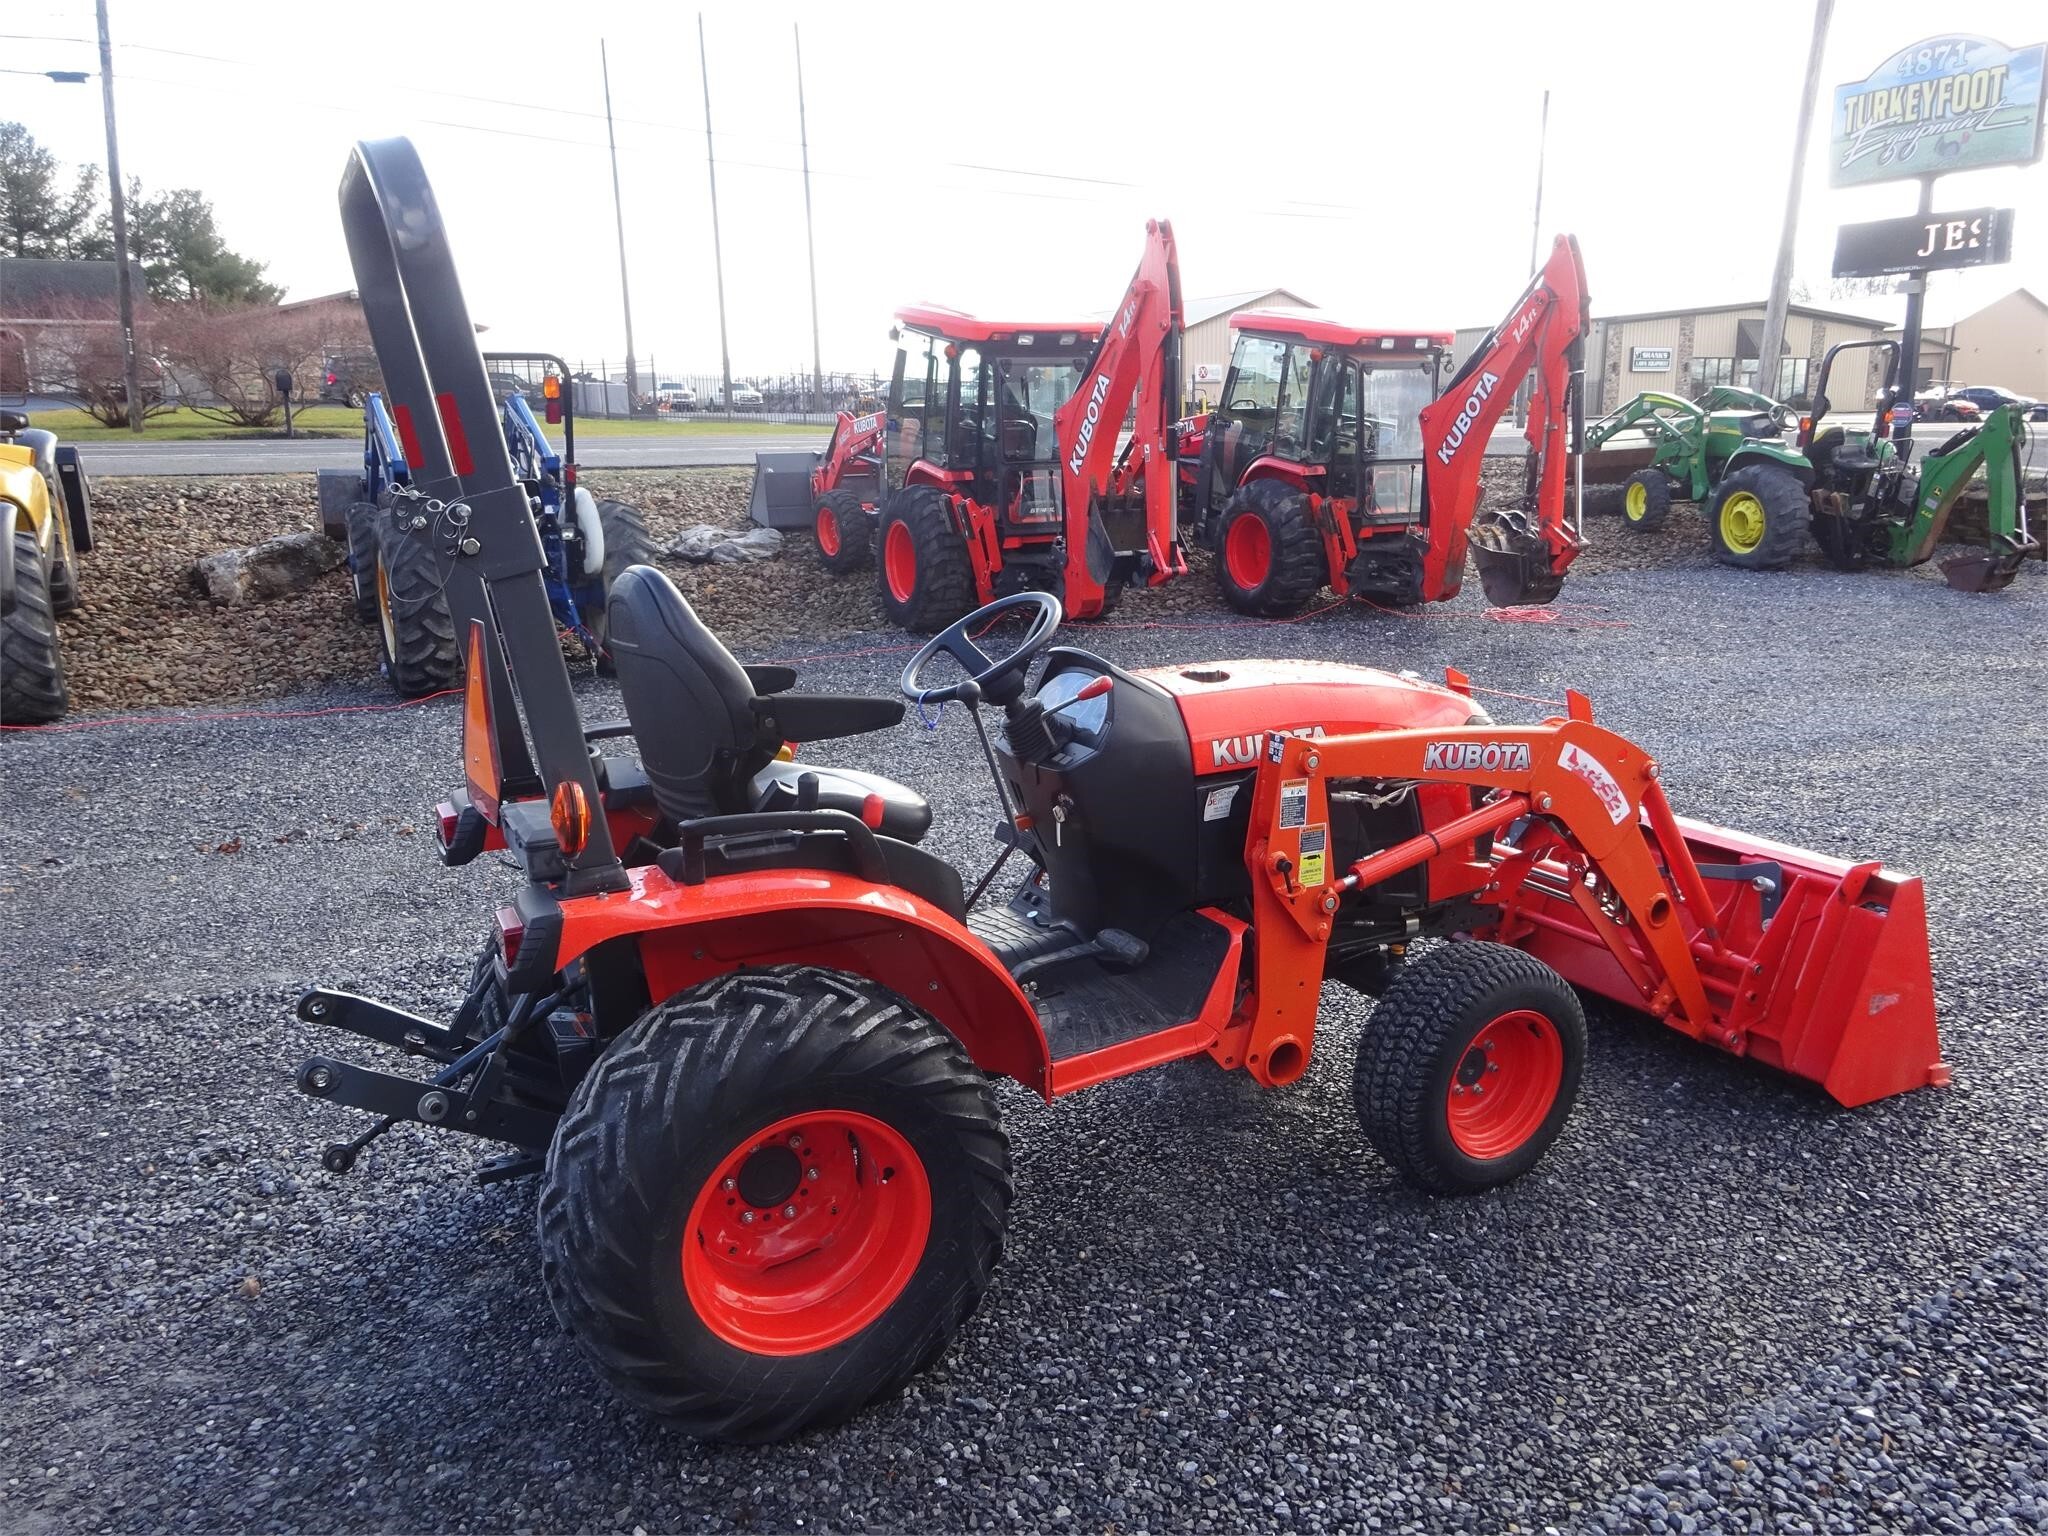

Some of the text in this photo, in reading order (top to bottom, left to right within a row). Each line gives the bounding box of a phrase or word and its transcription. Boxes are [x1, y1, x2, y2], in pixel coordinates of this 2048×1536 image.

[1898, 41, 1968, 78] 4871
[1840, 97, 2031, 168] Equipment
[1845, 64, 2008, 134] TURKEYFOOT
[854, 416, 877, 434] KUBOTA
[1069, 373, 1110, 475] KUBOTA
[1437, 371, 1498, 464] KUBOTA
[1424, 743, 1530, 770] KUBOTA
